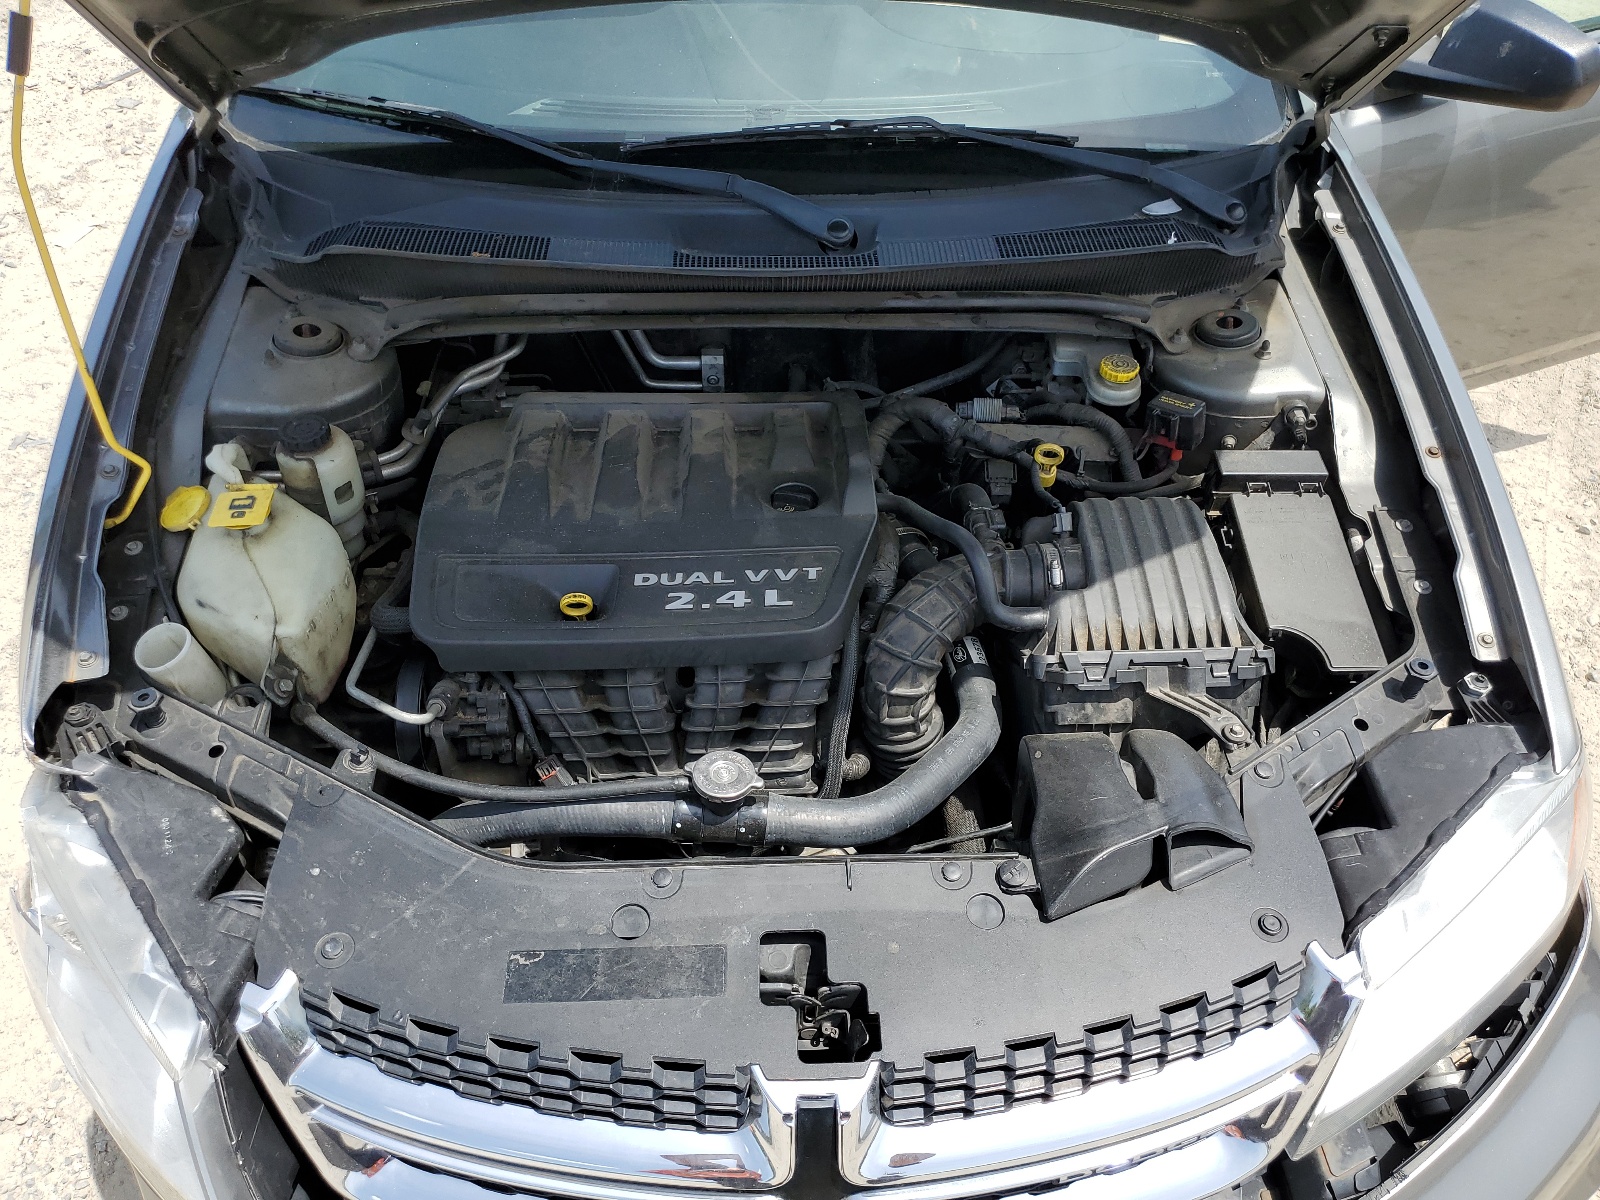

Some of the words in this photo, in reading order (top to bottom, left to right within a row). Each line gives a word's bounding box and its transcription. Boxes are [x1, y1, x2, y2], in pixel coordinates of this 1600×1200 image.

[633, 571, 735, 587] DUAL
[744, 566, 823, 582] VVT
[664, 590, 752, 610] 2.4
[764, 589, 794, 607] L
